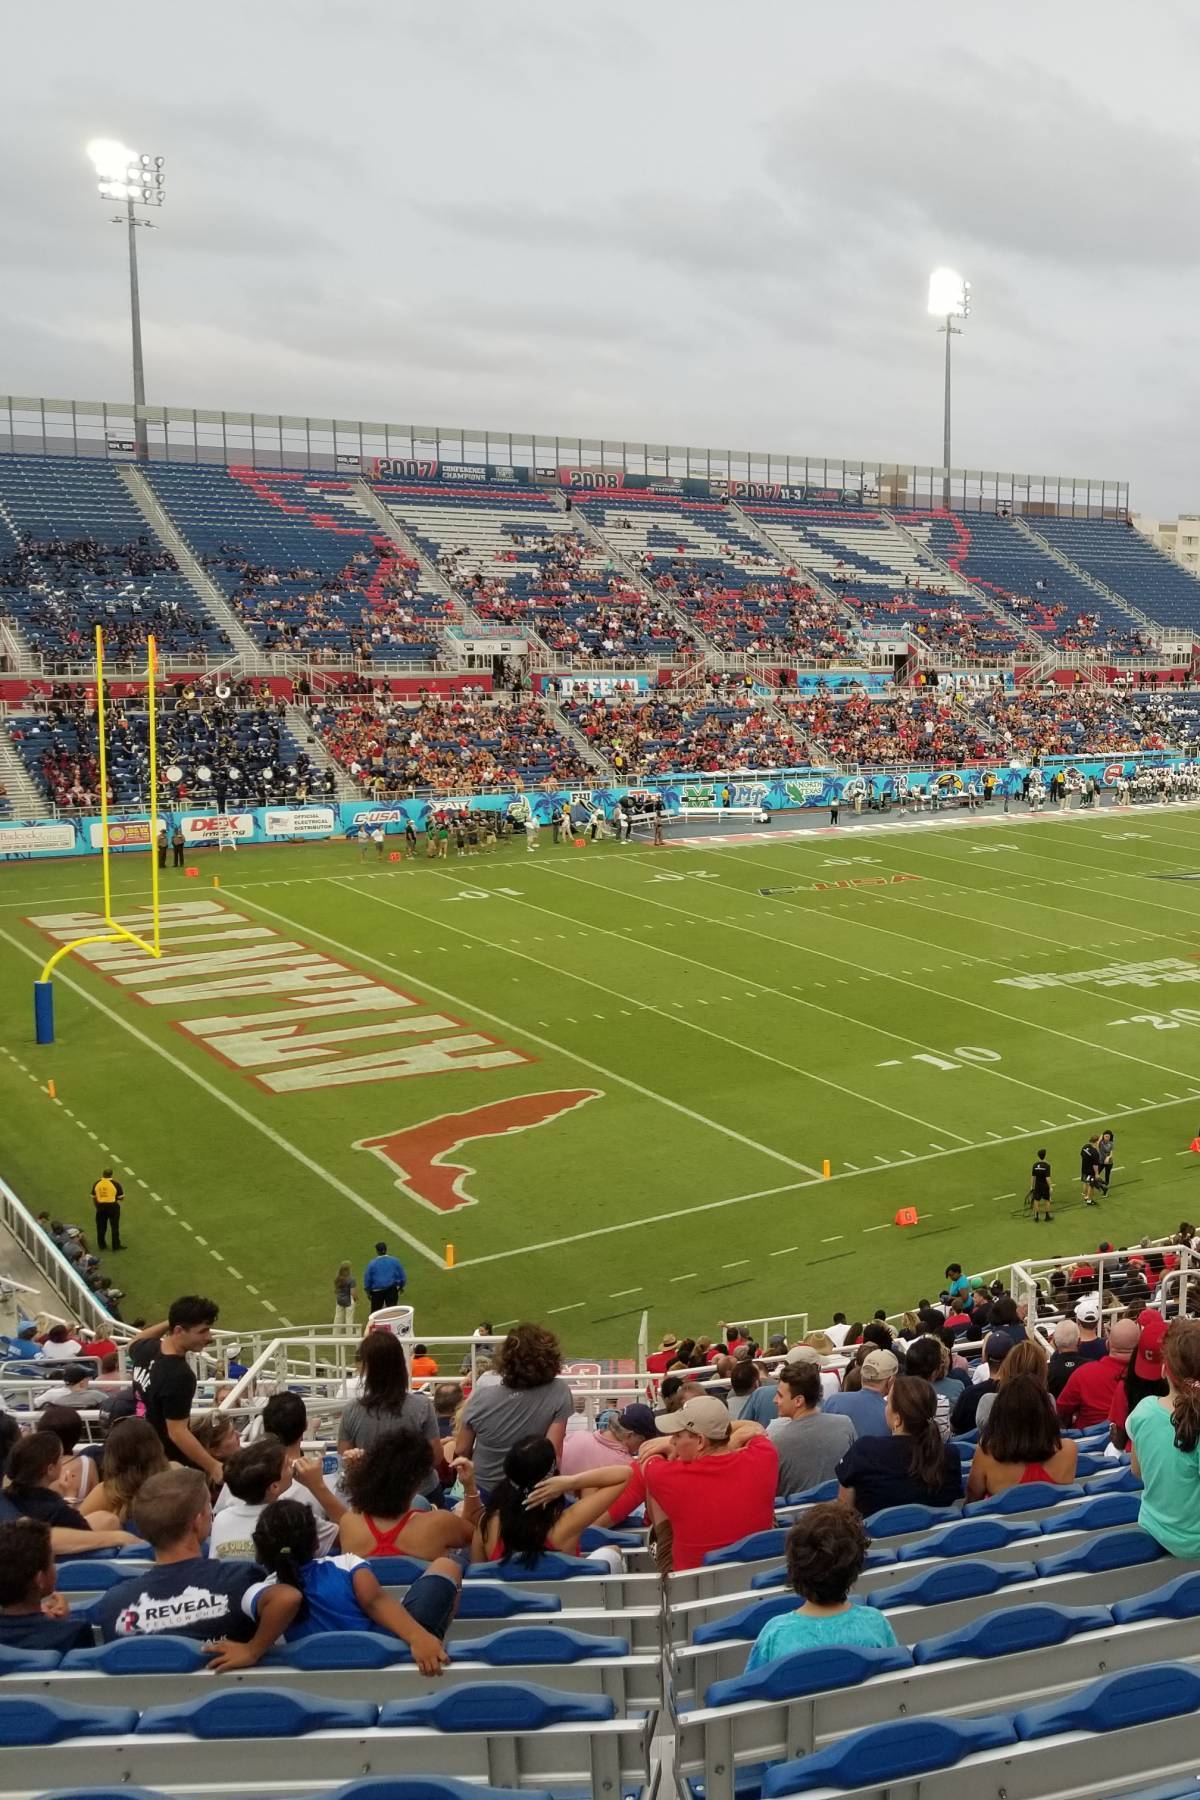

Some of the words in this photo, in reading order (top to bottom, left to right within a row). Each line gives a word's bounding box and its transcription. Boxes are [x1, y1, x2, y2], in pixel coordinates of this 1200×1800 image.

[378, 458, 433, 477] 2007
[442, 465, 486, 474] CONFERENCE
[442, 472, 486, 481] CHAMPIONS
[570, 472, 619, 488] 2008
[736, 482, 777, 497] 2017
[780, 489, 801, 500] 11-3
[911, 1046, 1002, 1071] 10
[145, 1595, 222, 1620] REVEAL
[145, 1607, 224, 1627] FELLOWSHIP
